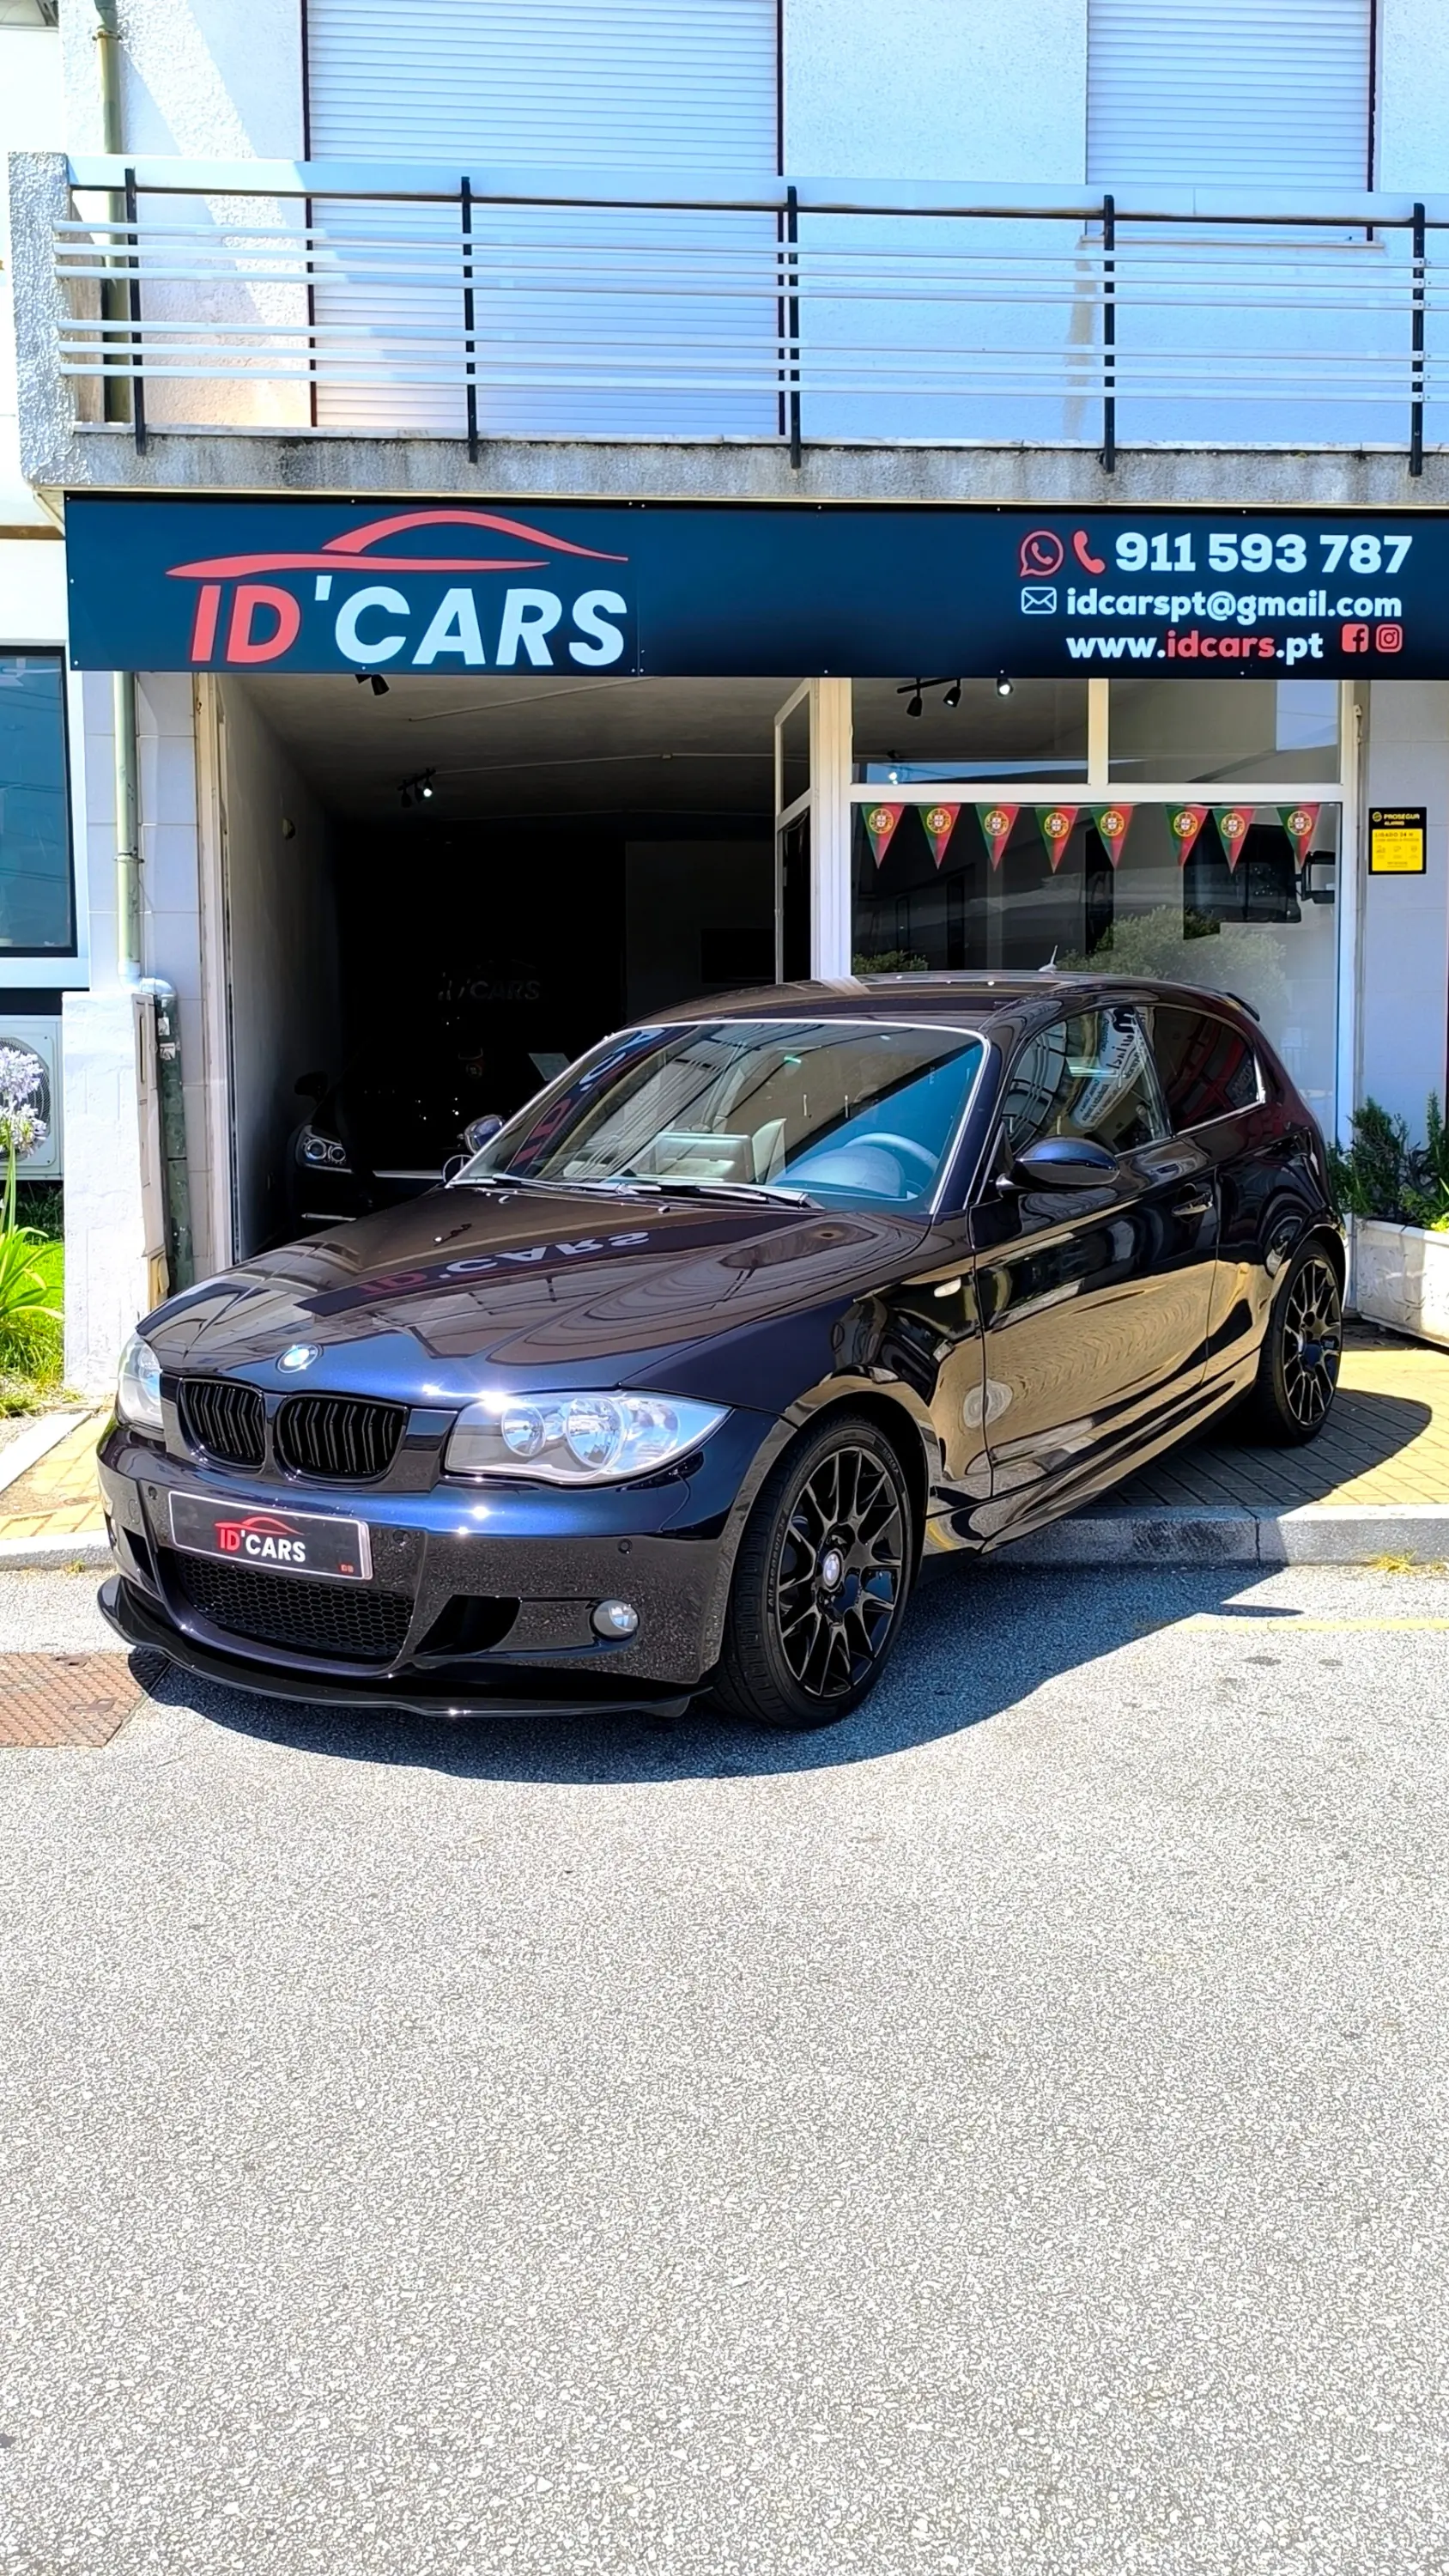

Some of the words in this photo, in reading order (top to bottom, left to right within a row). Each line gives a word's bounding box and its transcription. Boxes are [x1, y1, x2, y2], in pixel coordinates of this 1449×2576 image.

[1115, 532, 1196, 572] 911
[1208, 532, 1307, 574] 593
[1319, 534, 1413, 574] 787
[190, 574, 628, 666] ID'CARS
[1066, 586, 1403, 626] idcarspt@gmail.com
[1065, 629, 1325, 665] www.idcars.pt
[220, 1528, 306, 1562] ID'CARS
